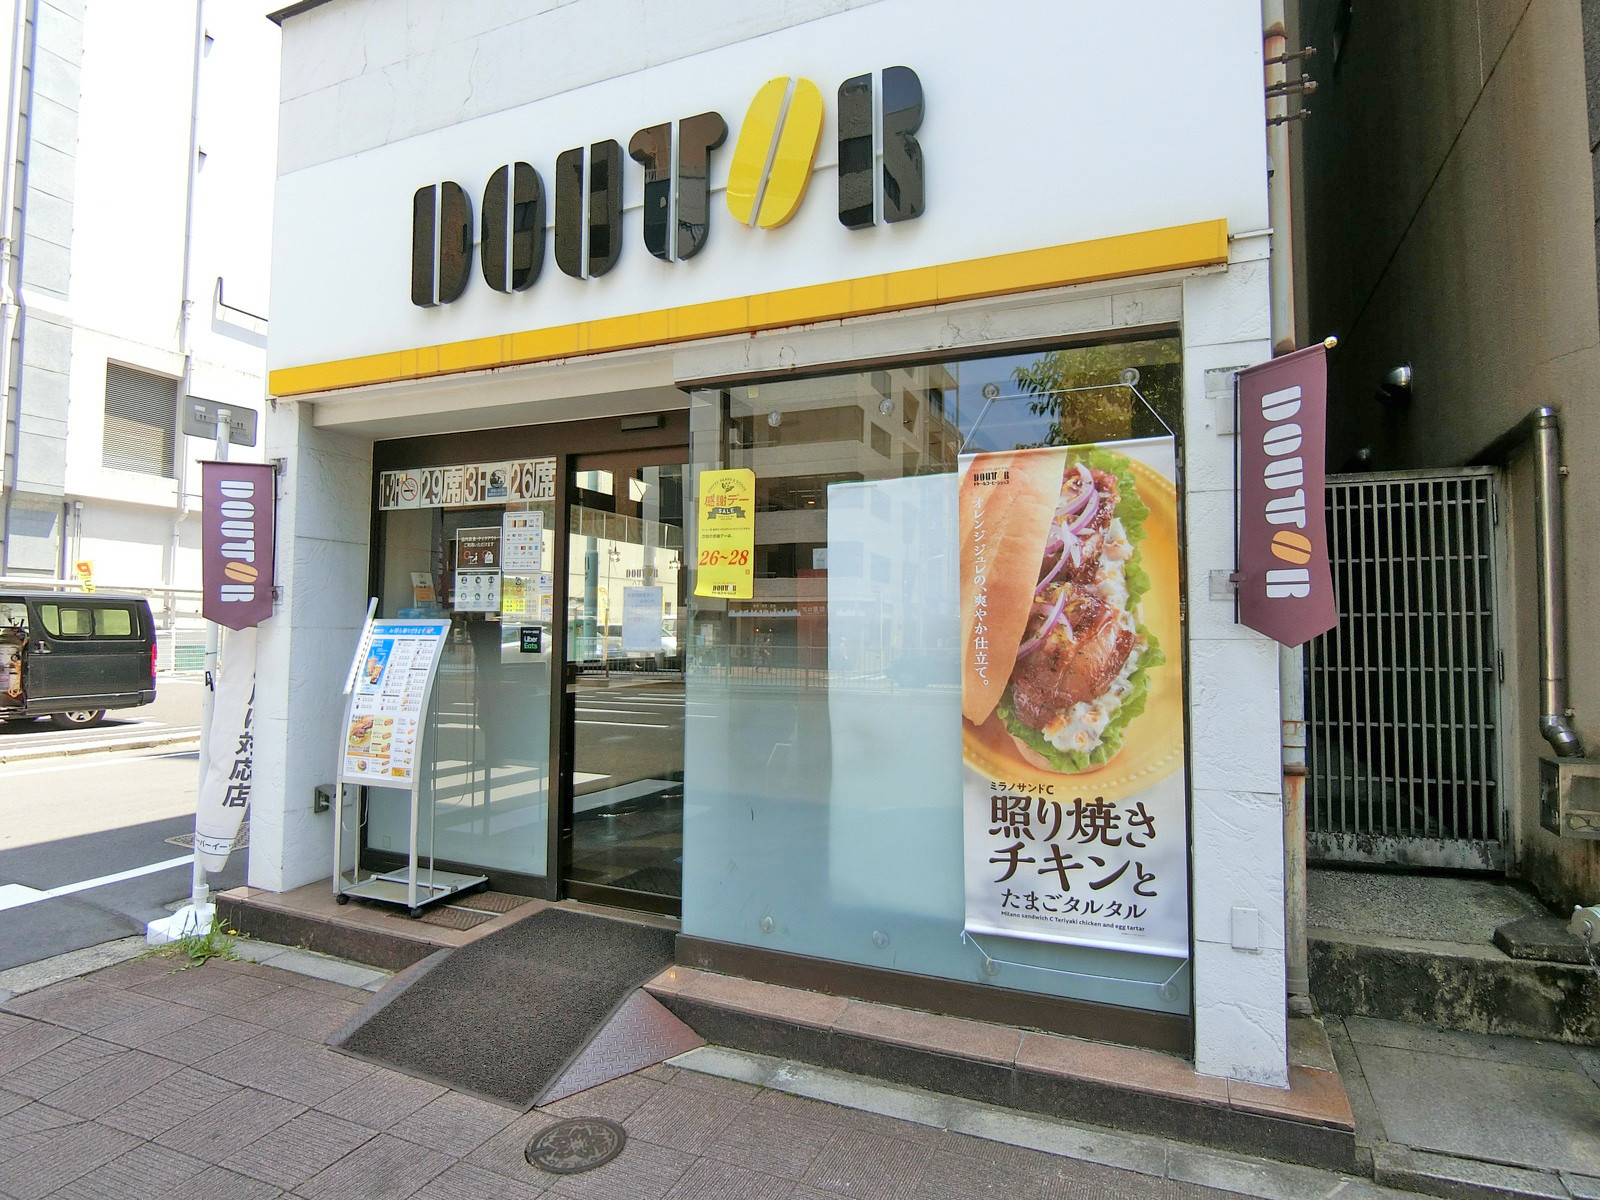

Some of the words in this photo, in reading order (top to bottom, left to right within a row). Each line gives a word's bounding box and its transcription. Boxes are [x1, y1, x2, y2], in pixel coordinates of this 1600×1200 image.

[411, 65, 926, 309] DOUTOR
[421, 469, 463, 504] 29席
[465, 466, 487, 502] 3F
[511, 460, 557, 500] 26席
[973, 471, 1010, 482] DOUTOR
[1260, 385, 1311, 599] DOUTOR
[704, 494, 749, 507] 感謝デー
[220, 480, 259, 603] DOUTOR
[626, 568, 659, 578] DOUTOR
[972, 497, 989, 687] オレンジジュレの、爽やか仕立て。
[990, 781, 1054, 796] ミラノサンドC
[988, 795, 1156, 848] 照り焼き
[988, 840, 1157, 897] チキンと
[1001, 887, 1147, 921] たまごタルタル
[1001, 910, 1020, 918] Milano
[1021, 912, 1049, 922] sandwich
[1054, 916, 1078, 926] Teriyaki
[1079, 918, 1101, 927] chicken
[1115, 924, 1126, 932] egg
[1126, 924, 1145, 932] tartar
